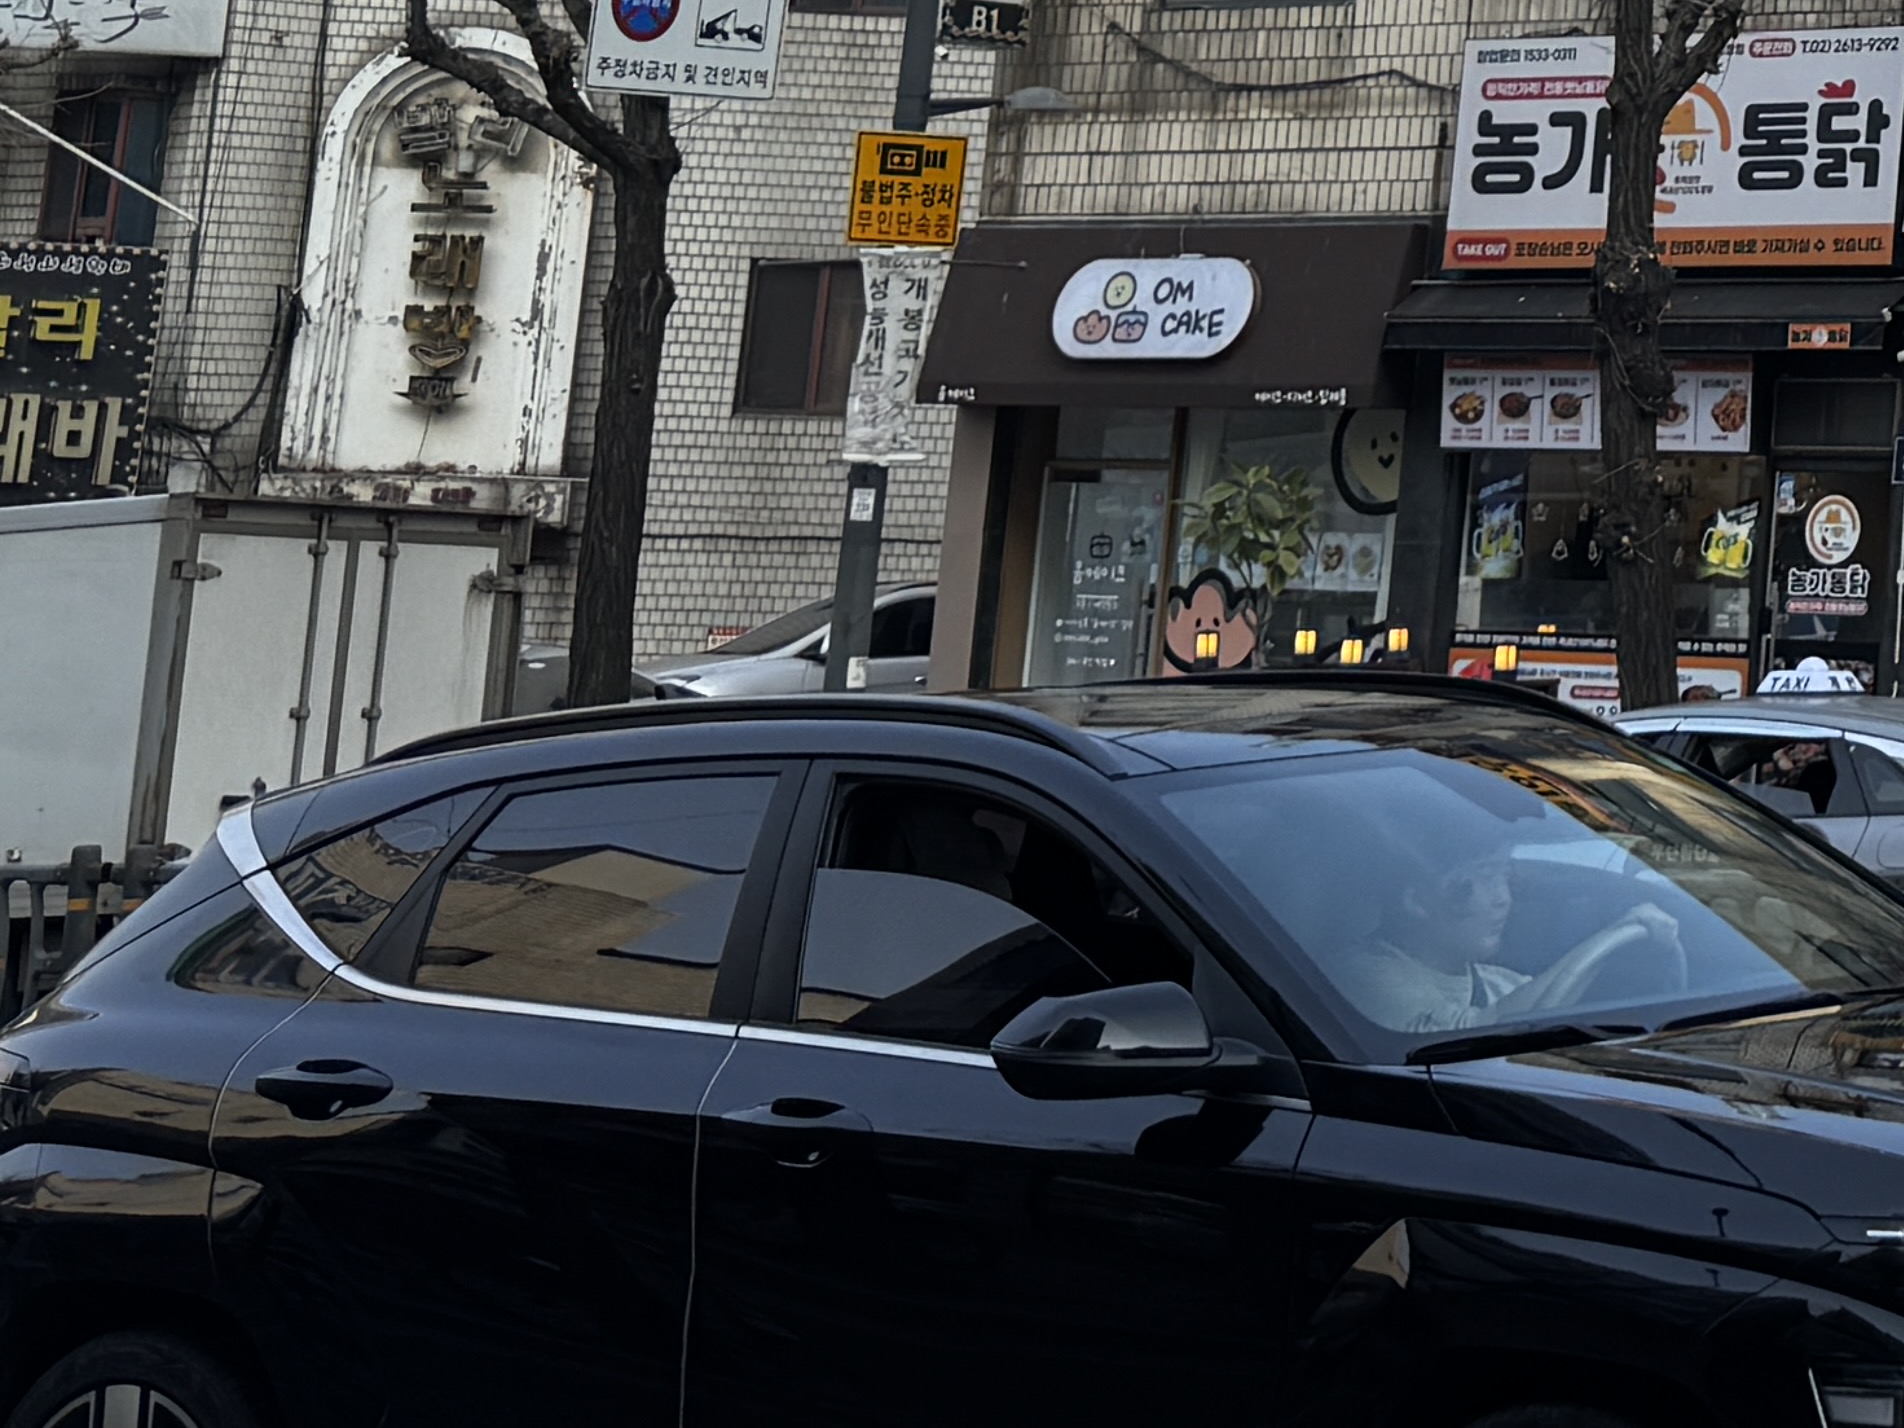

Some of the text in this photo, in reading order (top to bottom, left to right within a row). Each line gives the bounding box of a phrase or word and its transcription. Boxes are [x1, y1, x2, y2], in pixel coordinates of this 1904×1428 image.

[970, 5, 1001, 34] B1
[597, 56, 770, 89] 주정차금지 및 견인지역
[1736, 98, 1892, 191] 통닭
[854, 209, 952, 240] 무인단속중
[1152, 276, 1195, 306] OM
[1160, 307, 1225, 339] CAKE
[1770, 676, 1810, 692] TAXI
